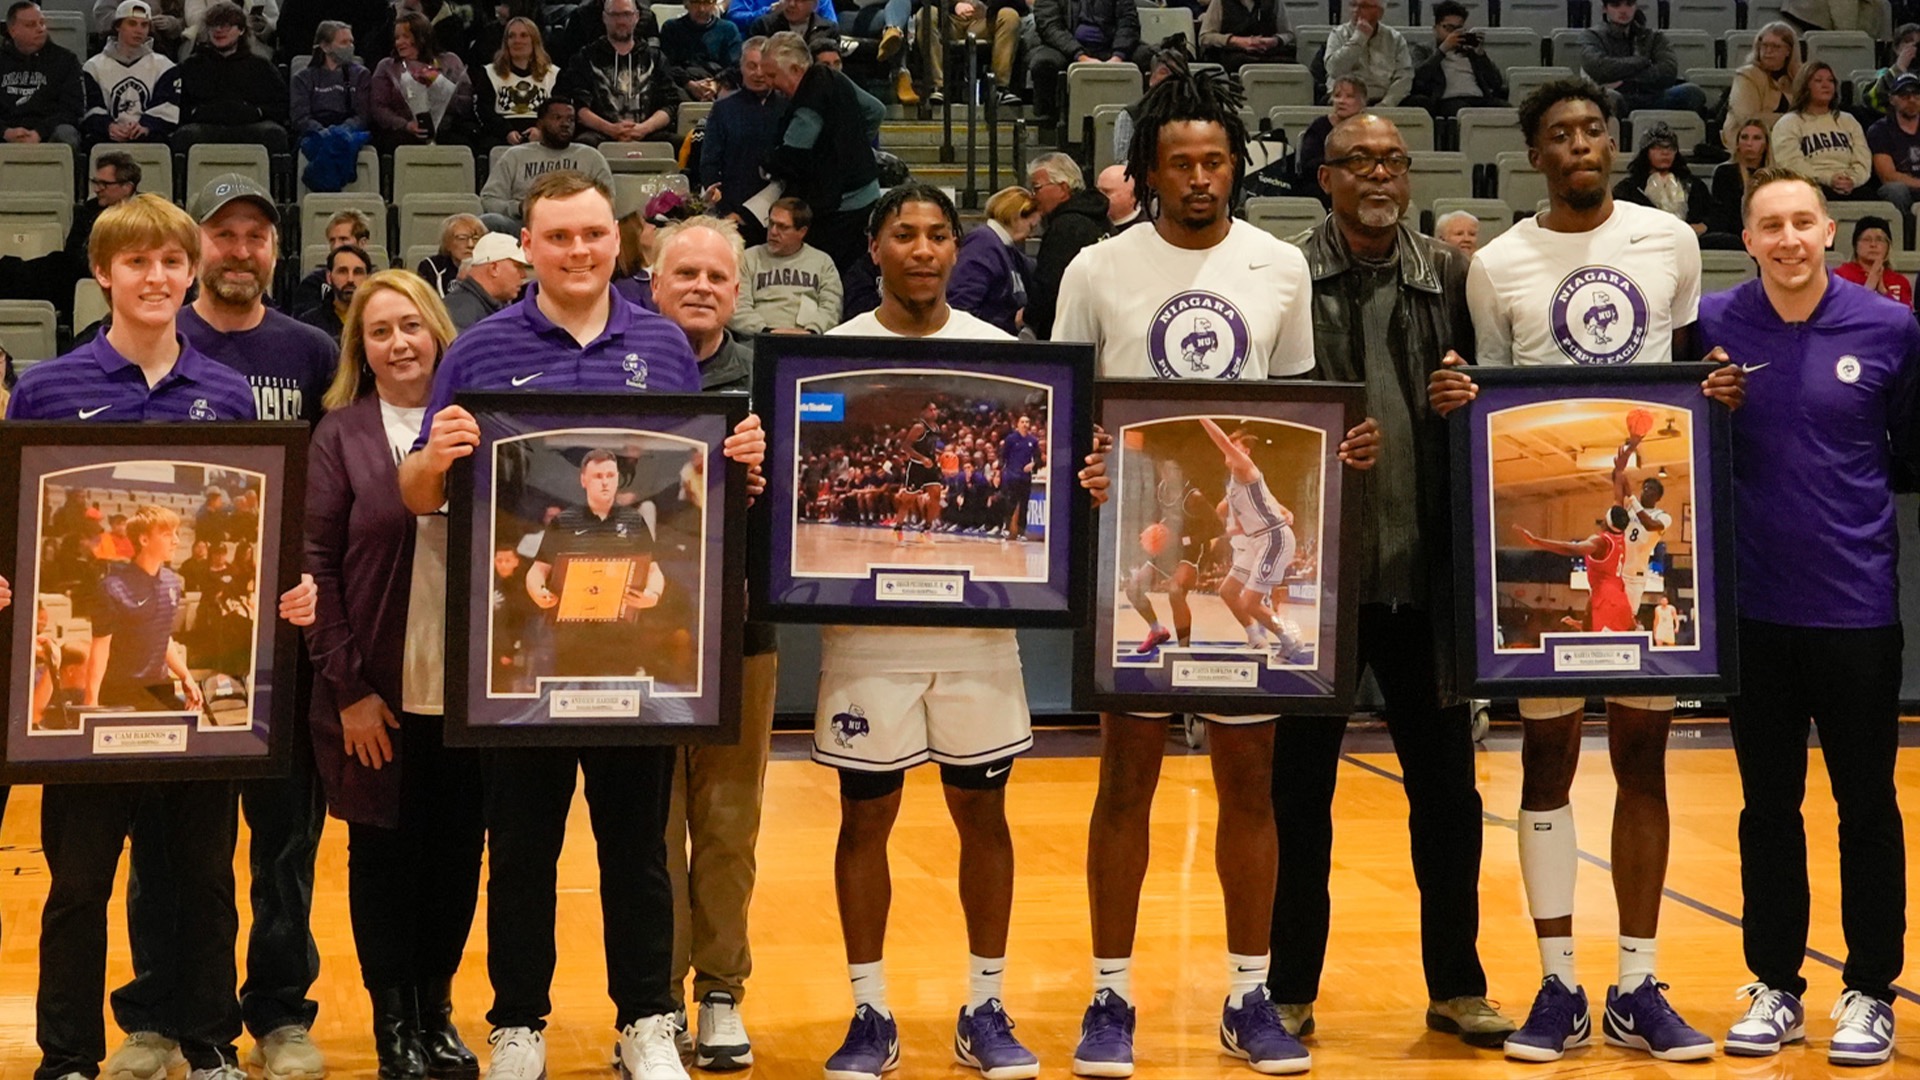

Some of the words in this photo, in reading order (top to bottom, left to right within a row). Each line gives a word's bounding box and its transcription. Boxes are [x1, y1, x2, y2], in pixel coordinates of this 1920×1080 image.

[1800, 130, 1854, 157] NIAGAR
[756, 267, 820, 293] NIAGARA
[1559, 271, 1630, 304] NIAGARA
[1160, 297, 1236, 324] NIAGARA
[1598, 310, 1612, 320] NU
[1197, 337, 1211, 347] NU
[1562, 337, 1605, 365] PURPLE
[1607, 326, 1643, 365] EAGLES
[250, 375, 299, 389] VERSITY
[1629, 527, 1640, 542] 8
[1676, 700, 1702, 708] NICS
[849, 720, 861, 730] NU
